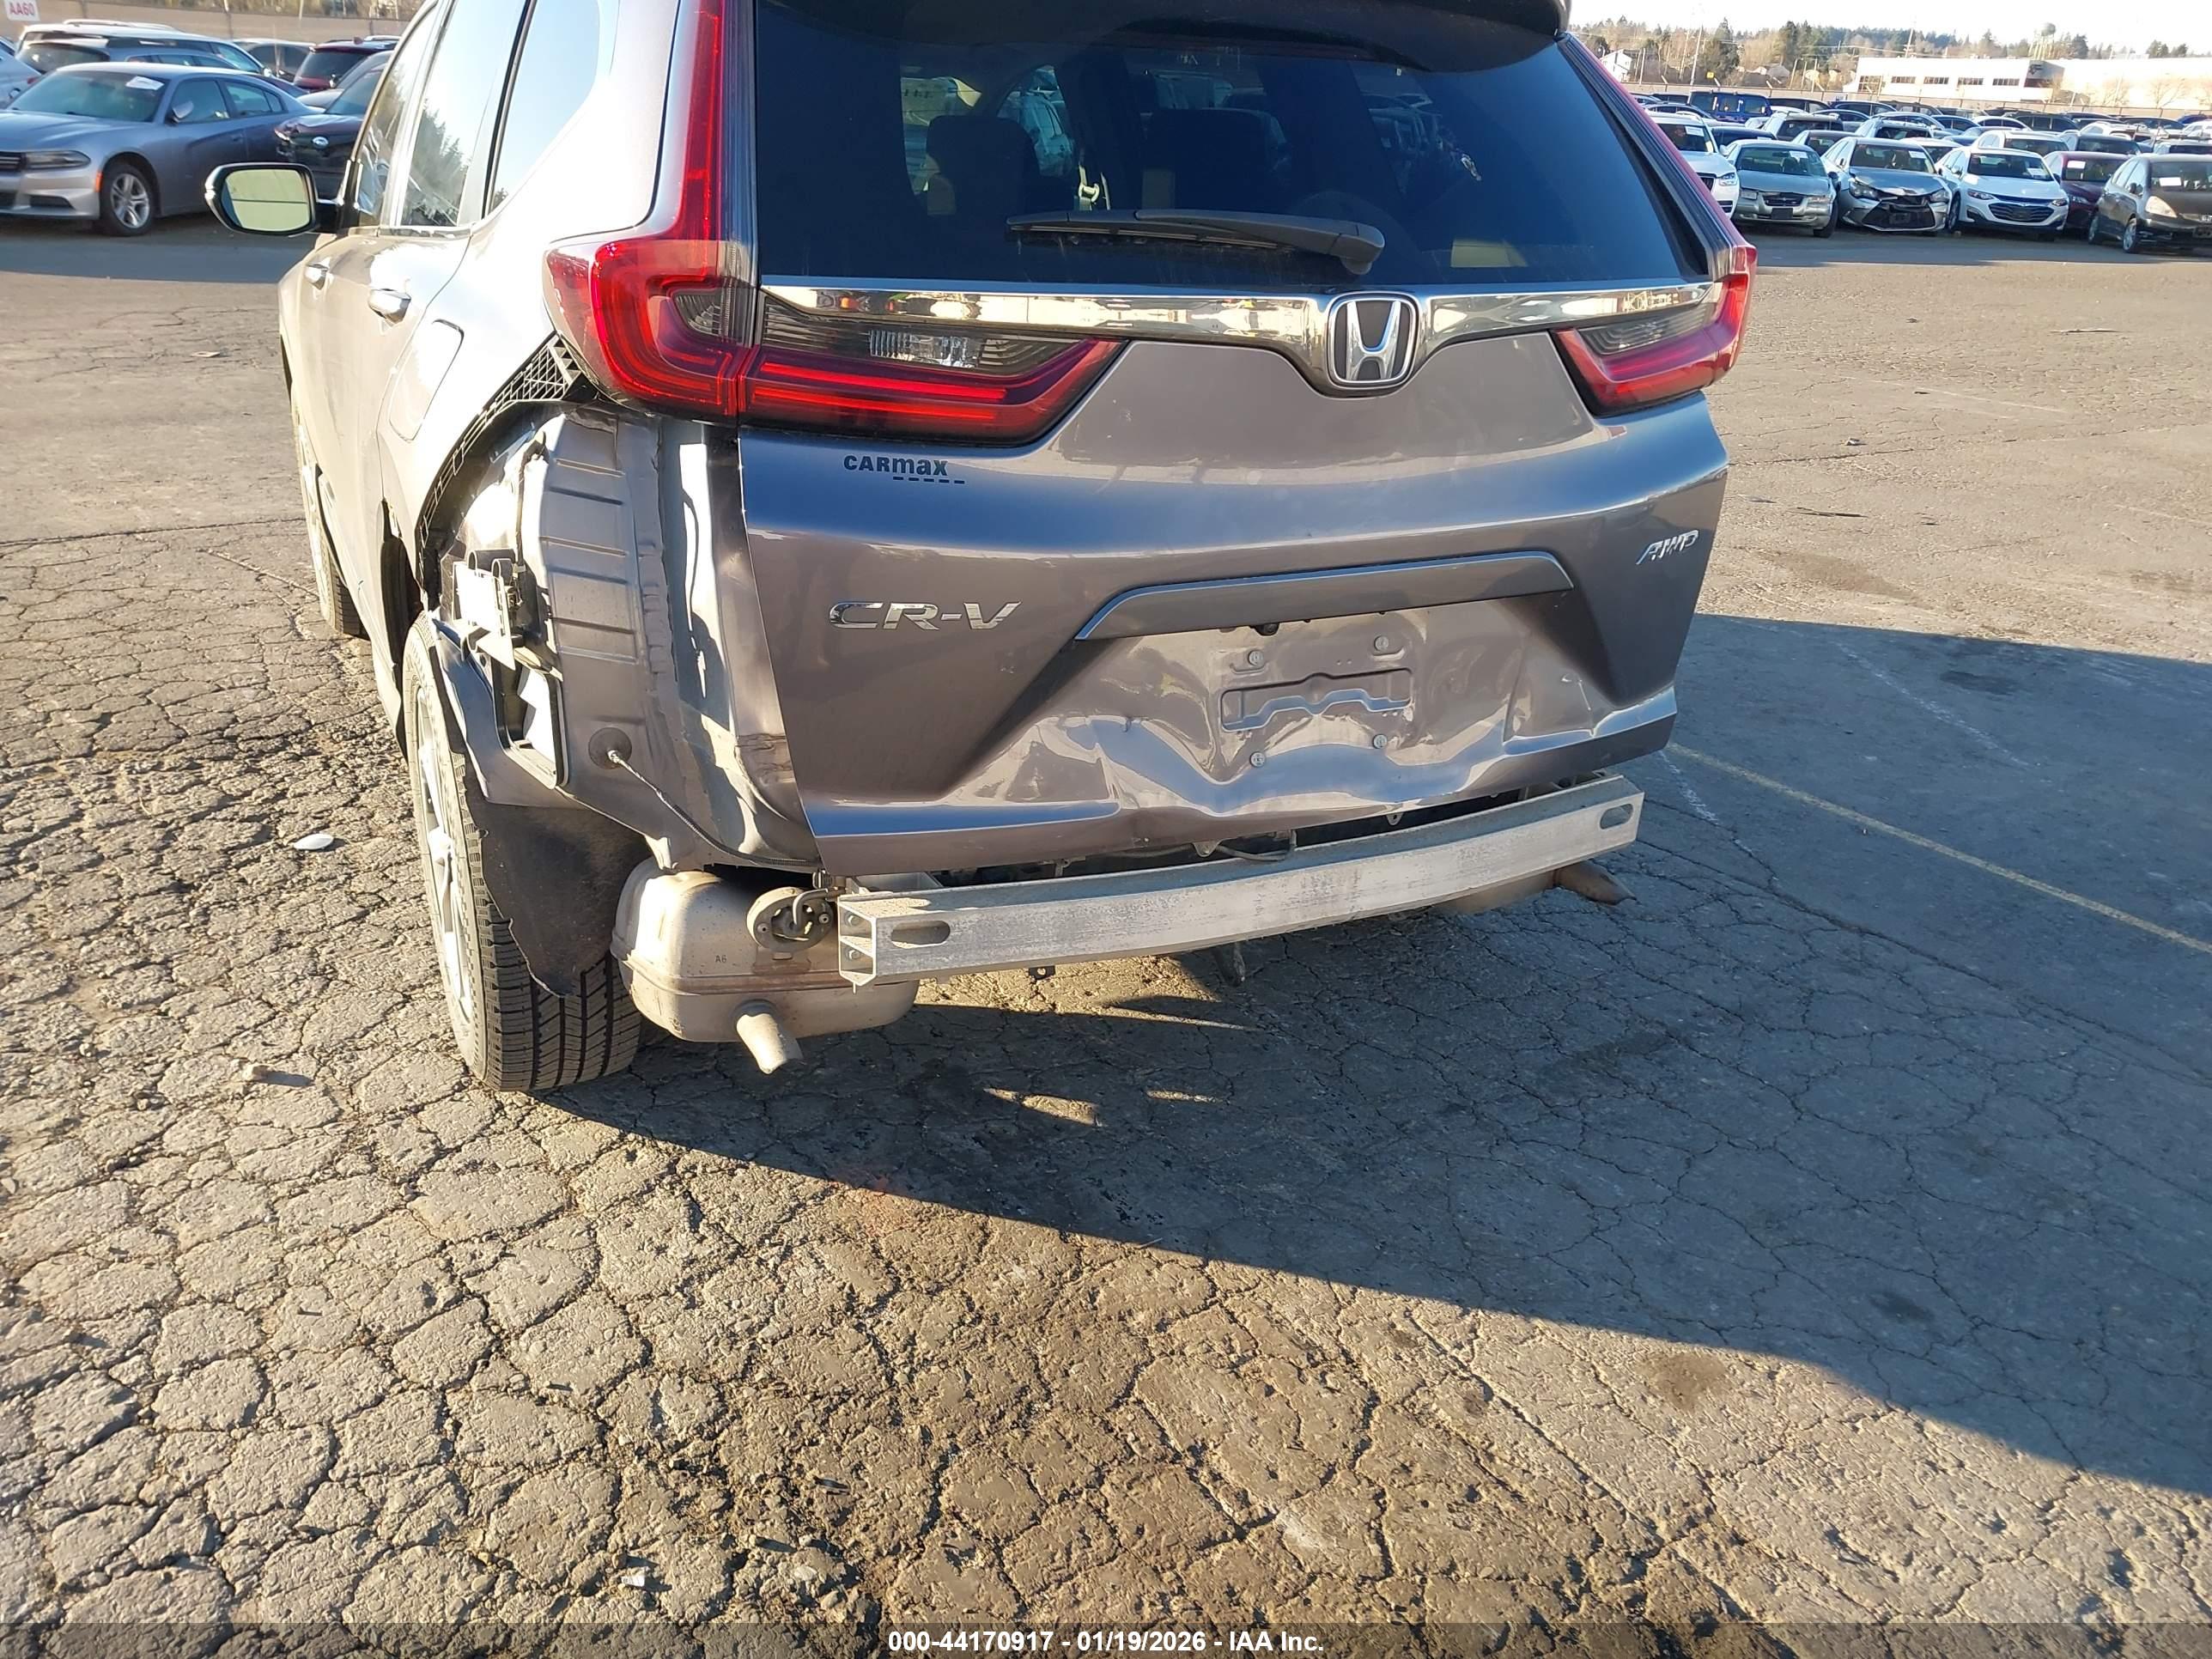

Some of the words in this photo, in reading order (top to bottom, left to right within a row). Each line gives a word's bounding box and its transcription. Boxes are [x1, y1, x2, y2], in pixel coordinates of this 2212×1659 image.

[9, 2, 35, 15] AA60
[1635, 529, 1699, 565] AWD
[829, 602, 1022, 630] CR-V
